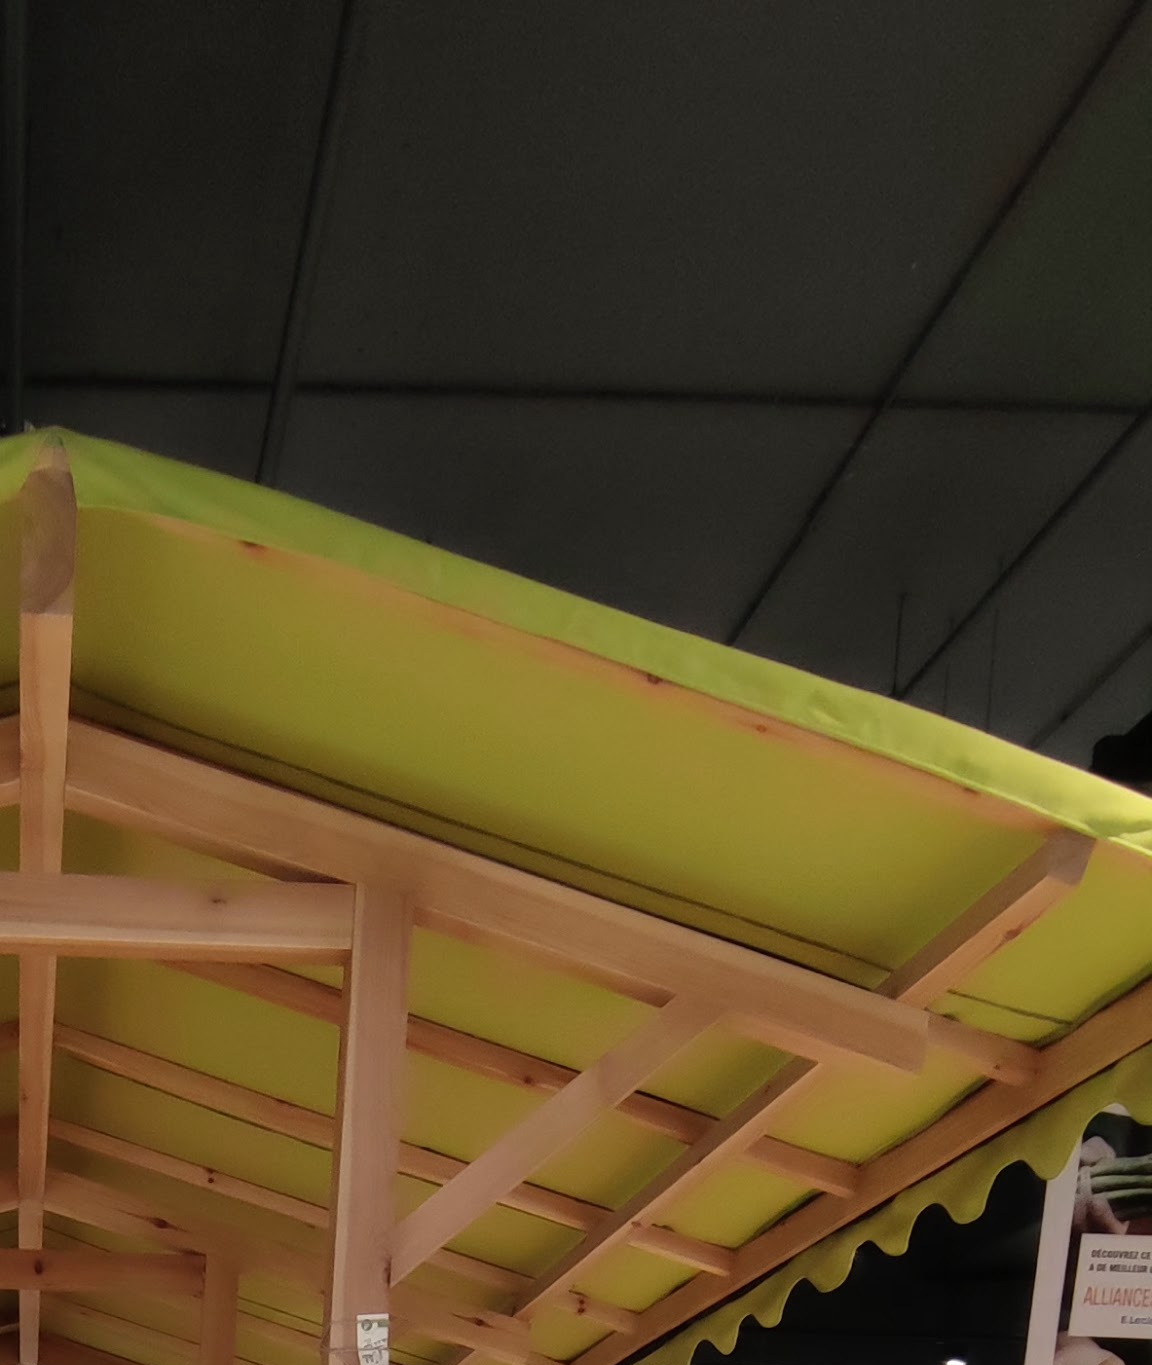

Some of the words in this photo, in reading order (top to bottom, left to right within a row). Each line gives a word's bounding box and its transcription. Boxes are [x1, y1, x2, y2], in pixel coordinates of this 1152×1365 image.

[1091, 1248, 1139, 1259] DÉCOUVREZ
[1109, 1264, 1147, 1273] MEILLEUR
[1083, 1286, 1152, 1307] ALLIANCE
